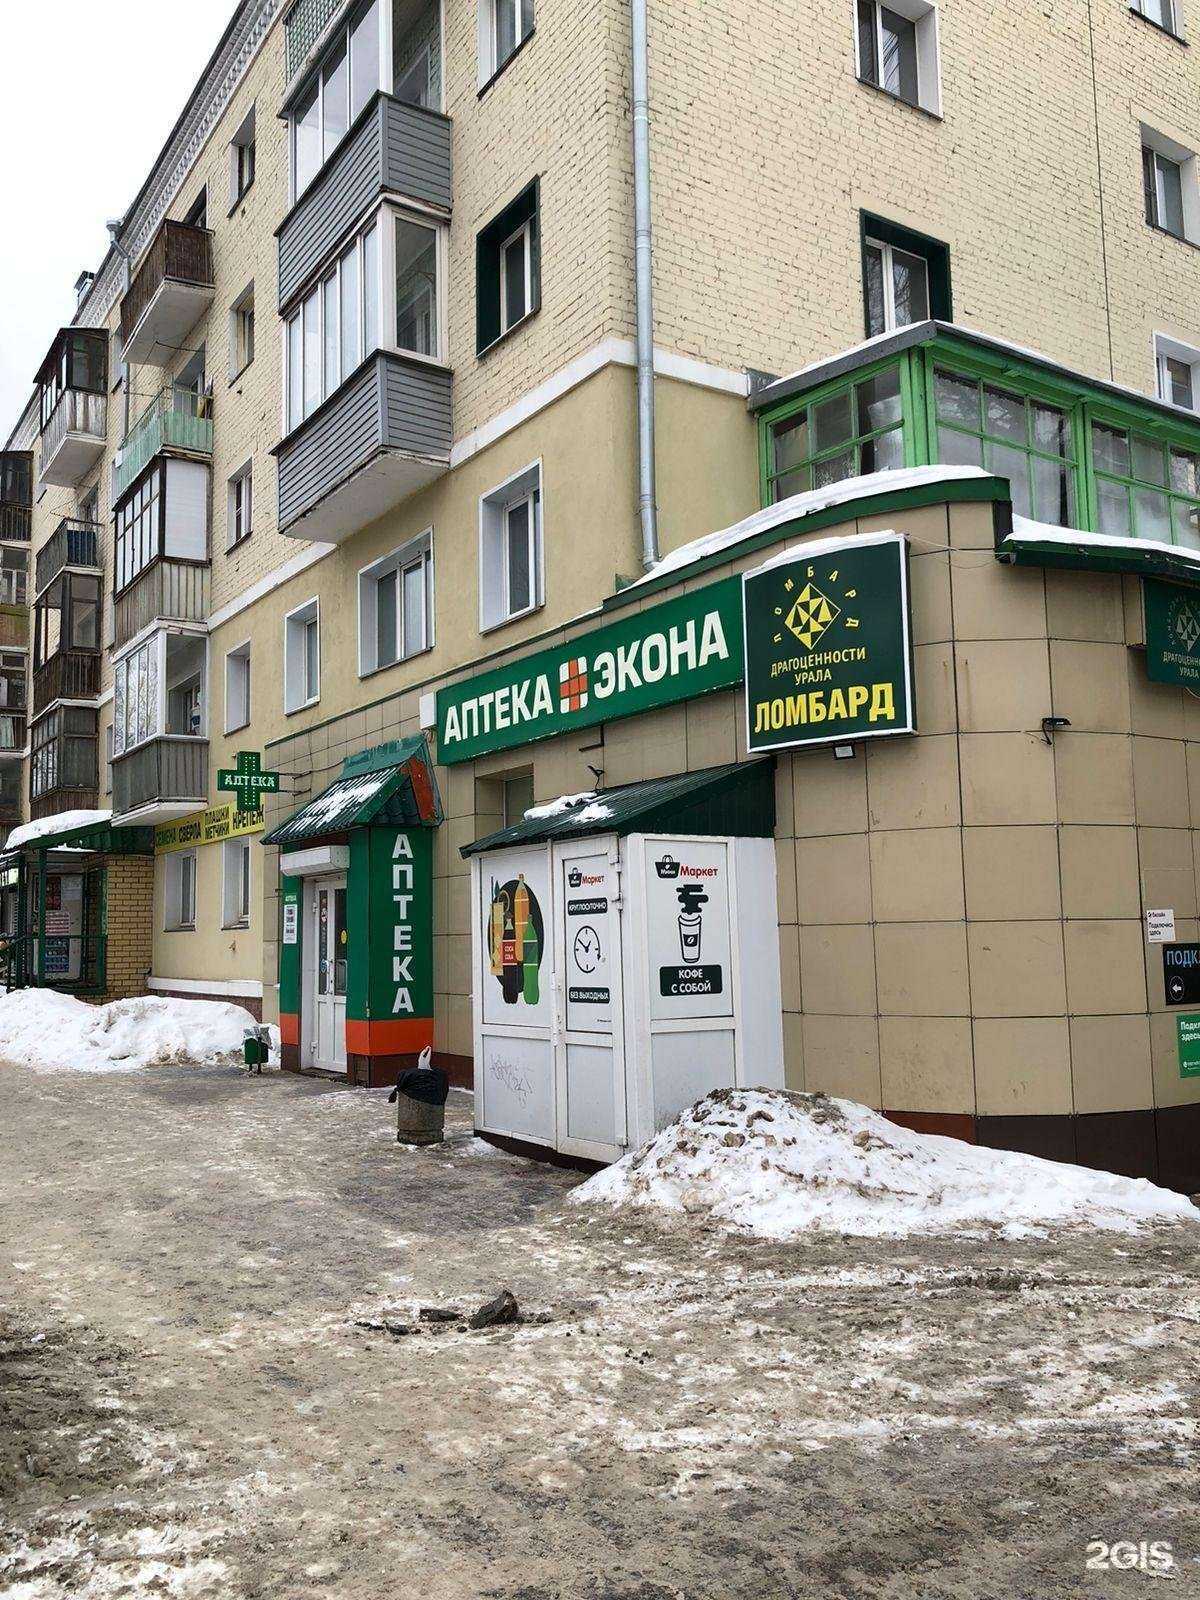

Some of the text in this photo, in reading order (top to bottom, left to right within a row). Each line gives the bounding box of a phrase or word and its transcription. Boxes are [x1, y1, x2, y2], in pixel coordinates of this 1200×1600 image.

[771, 647, 867, 678] ДРАГОЦЕННОСТИ
[443, 610, 730, 745] АПТЕКА ЭКОНА
[794, 668, 832, 686] УРАЛА
[754, 682, 896, 733] ЛОМБАРД
[224, 775, 275, 787] АПТЕКА
[680, 865, 718, 878] Маркет
[581, 875, 605, 885] Маркет
[568, 901, 607, 911] КРУГЛОСУТОЧНО
[392, 834, 414, 1013] АПТЕКА
[1166, 950, 1200, 967] ПОДК
[678, 969, 703, 979] КОФЕ
[671, 980, 711, 993] С СОБОЙ
[570, 991, 609, 1001] БЕЗ ВЫХОДНЫХ
